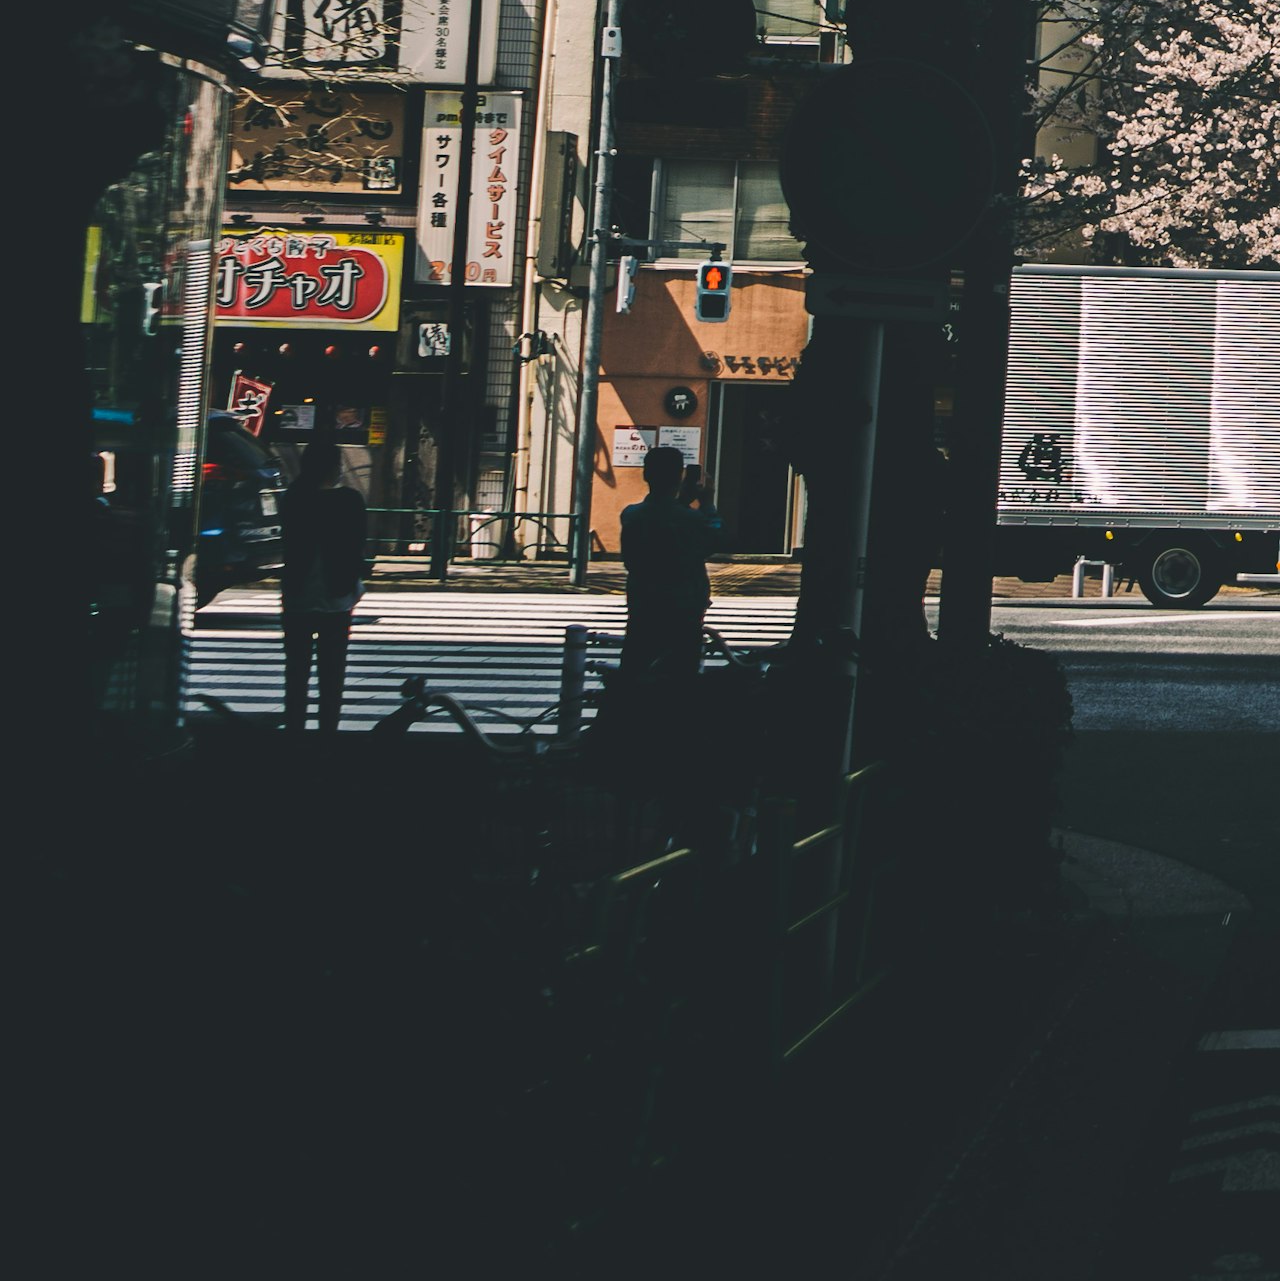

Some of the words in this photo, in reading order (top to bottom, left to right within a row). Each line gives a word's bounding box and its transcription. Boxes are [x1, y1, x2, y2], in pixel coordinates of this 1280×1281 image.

[431, 134, 451, 228] サワー各種
[483, 128, 508, 259] タイムサービス
[428, 261, 497, 283] 20円
